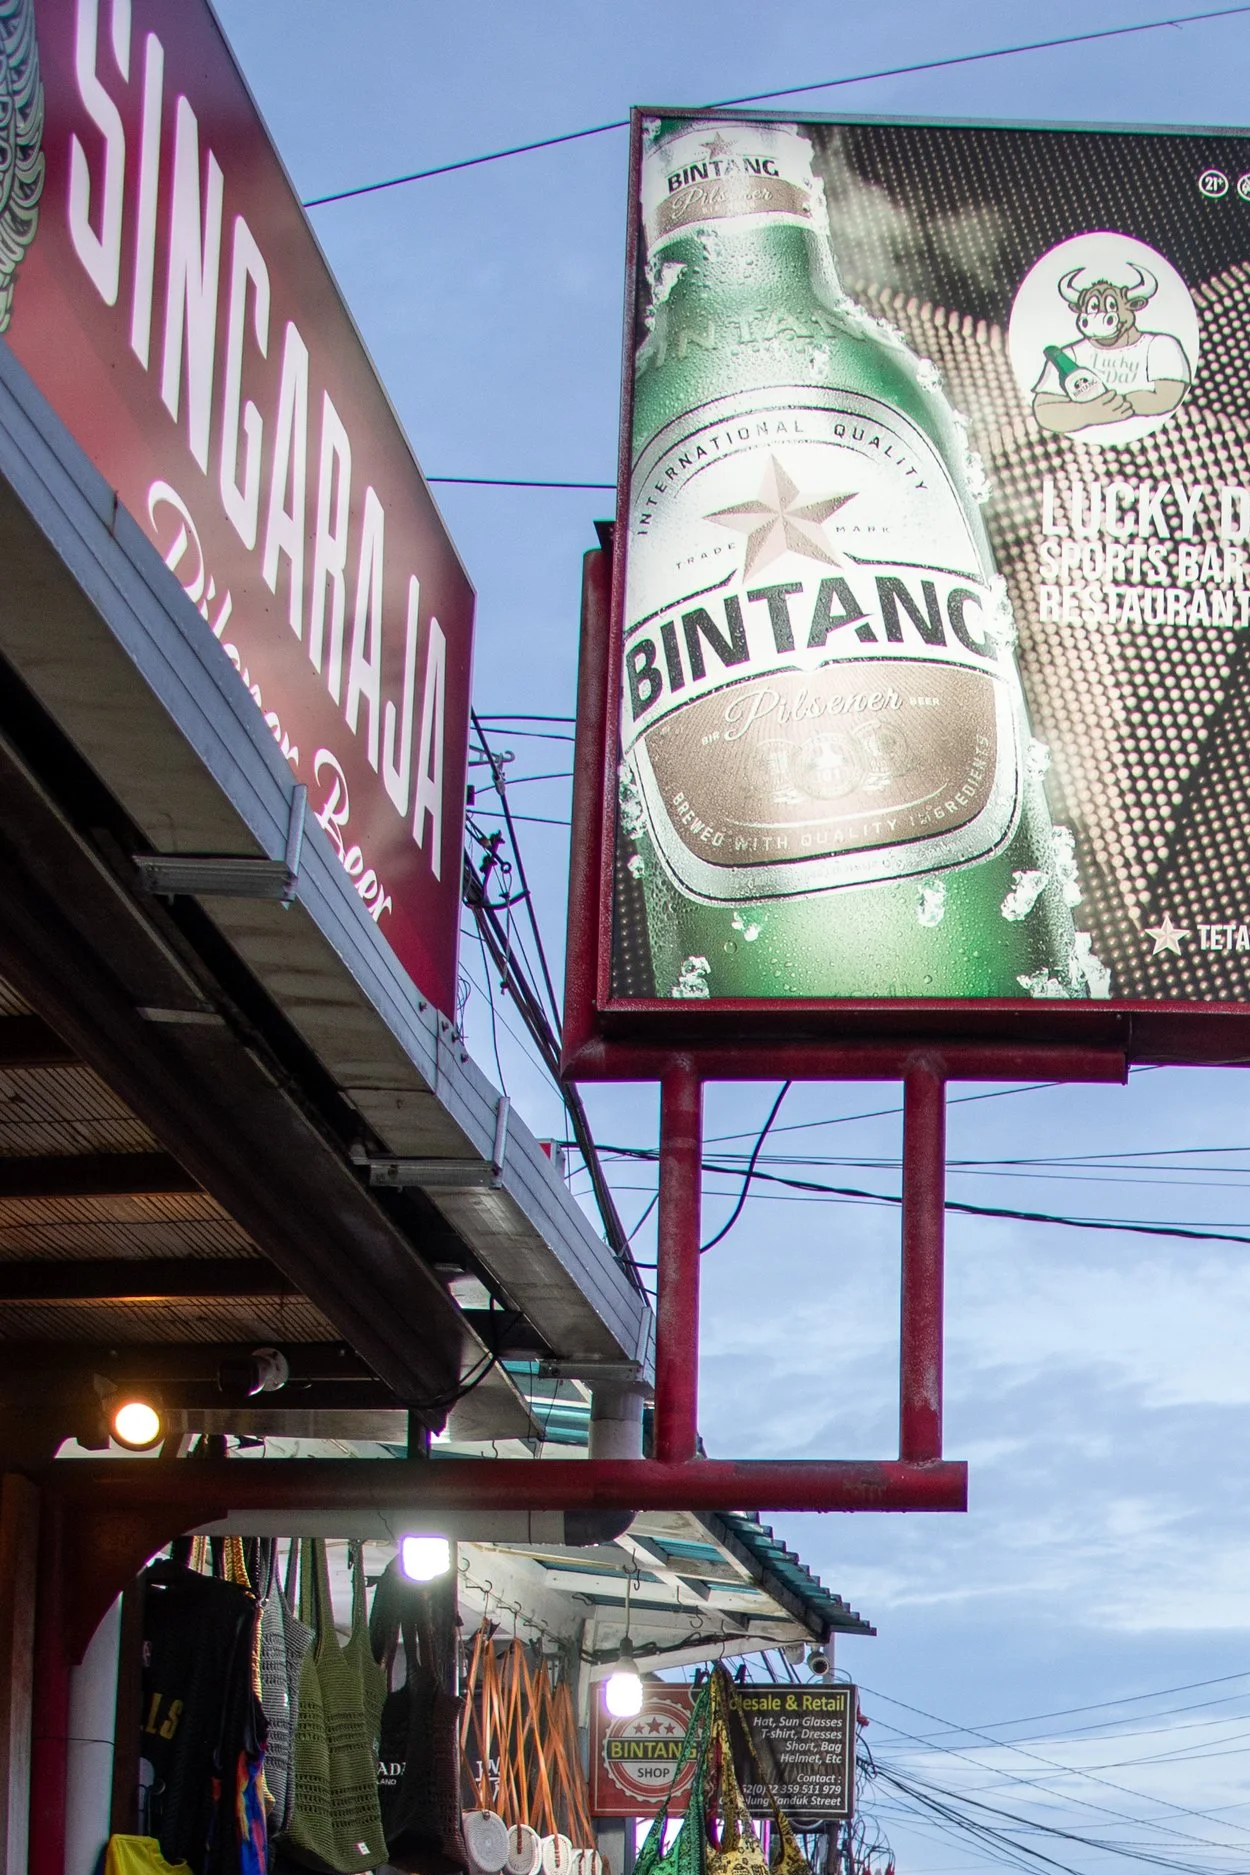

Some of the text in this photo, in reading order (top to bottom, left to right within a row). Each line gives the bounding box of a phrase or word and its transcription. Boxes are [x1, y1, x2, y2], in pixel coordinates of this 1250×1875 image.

[667, 157, 779, 194] BINTANG
[69, 0, 445, 882] SINGARAJA
[637, 420, 928, 536] INTERNATIONAL QUALITY
[1042, 480, 1204, 540] LUCKY
[675, 525, 891, 570] TRADE MARK
[1039, 542, 1168, 583] SPORTS
[1178, 545, 1244, 584] BAR
[723, 686, 904, 742] Pilsener
[910, 698, 940, 708] BEER
[672, 792, 725, 849] BREWED
[735, 835, 788, 851] WITH
[801, 818, 898, 847] QUALITY
[785, 1695, 798, 1711] &
[802, 1694, 845, 1711] Retail
[753, 1716, 843, 1728] Hat, Sun Glasses
[761, 1728, 842, 1740] T-shirt, Dresses
[786, 1740, 842, 1754] Short, Bag
[780, 1753, 843, 1765] Helmet, Etc
[637, 1767, 669, 1779] SHOP
[797, 1773, 835, 1784] Contact
[781, 1784, 800, 1796] 359
[801, 1784, 820, 1796] 511
[822, 1784, 842, 1796] 979
[811, 1796, 842, 1807] Street
